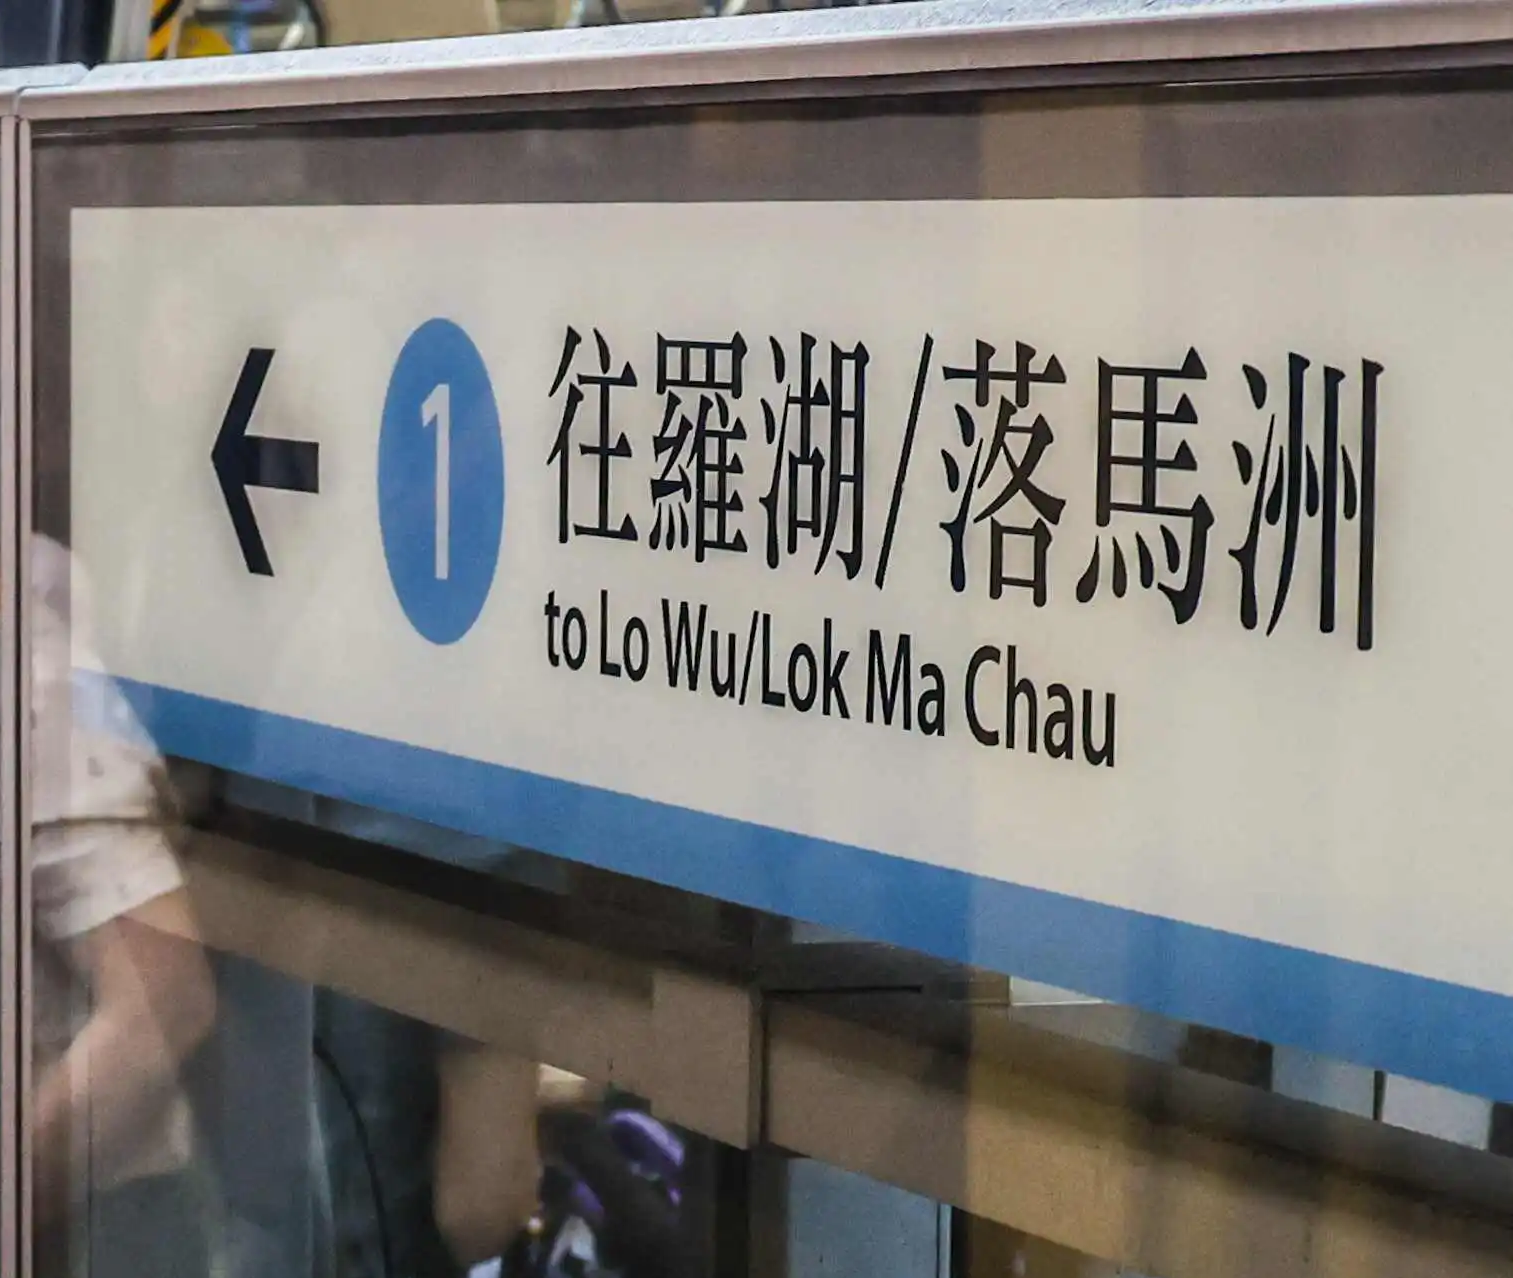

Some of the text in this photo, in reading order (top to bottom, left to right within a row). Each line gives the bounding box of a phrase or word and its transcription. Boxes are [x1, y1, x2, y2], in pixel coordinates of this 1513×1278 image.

[421, 383, 450, 580] 1
[546, 325, 1385, 651] 往羅湖/落馬洲
[544, 589, 1116, 768] to Lo Wu/Lok Ma Chau
